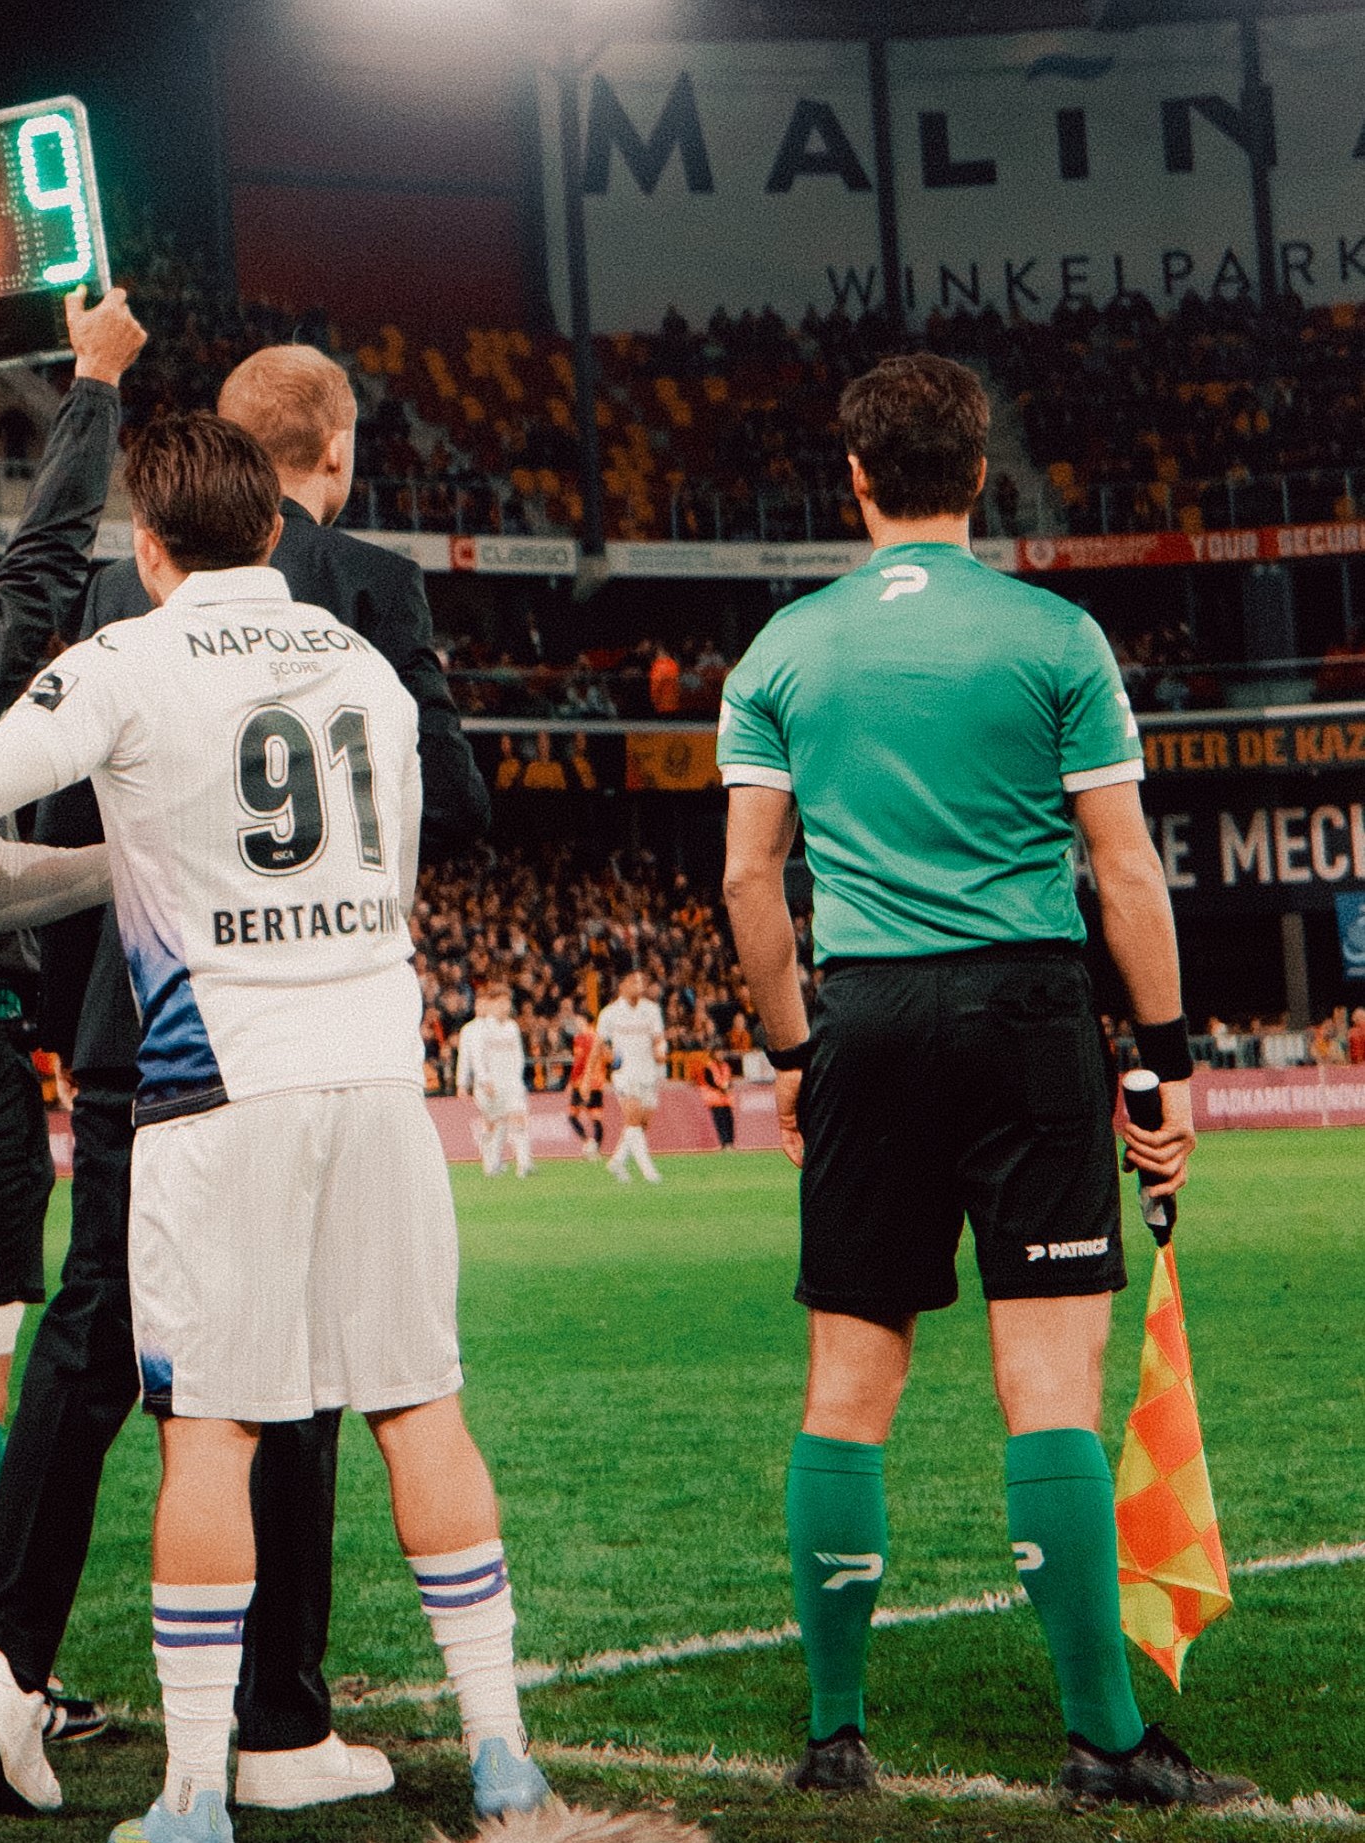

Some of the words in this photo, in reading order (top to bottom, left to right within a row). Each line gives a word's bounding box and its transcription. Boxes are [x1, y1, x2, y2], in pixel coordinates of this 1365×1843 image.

[17, 113, 91, 284] 9
[185, 625, 371, 659] NAPOLEON
[1237, 727, 1288, 768] DE
[234, 702, 387, 877] 91
[1048, 1237, 1110, 1260] PATRICK
